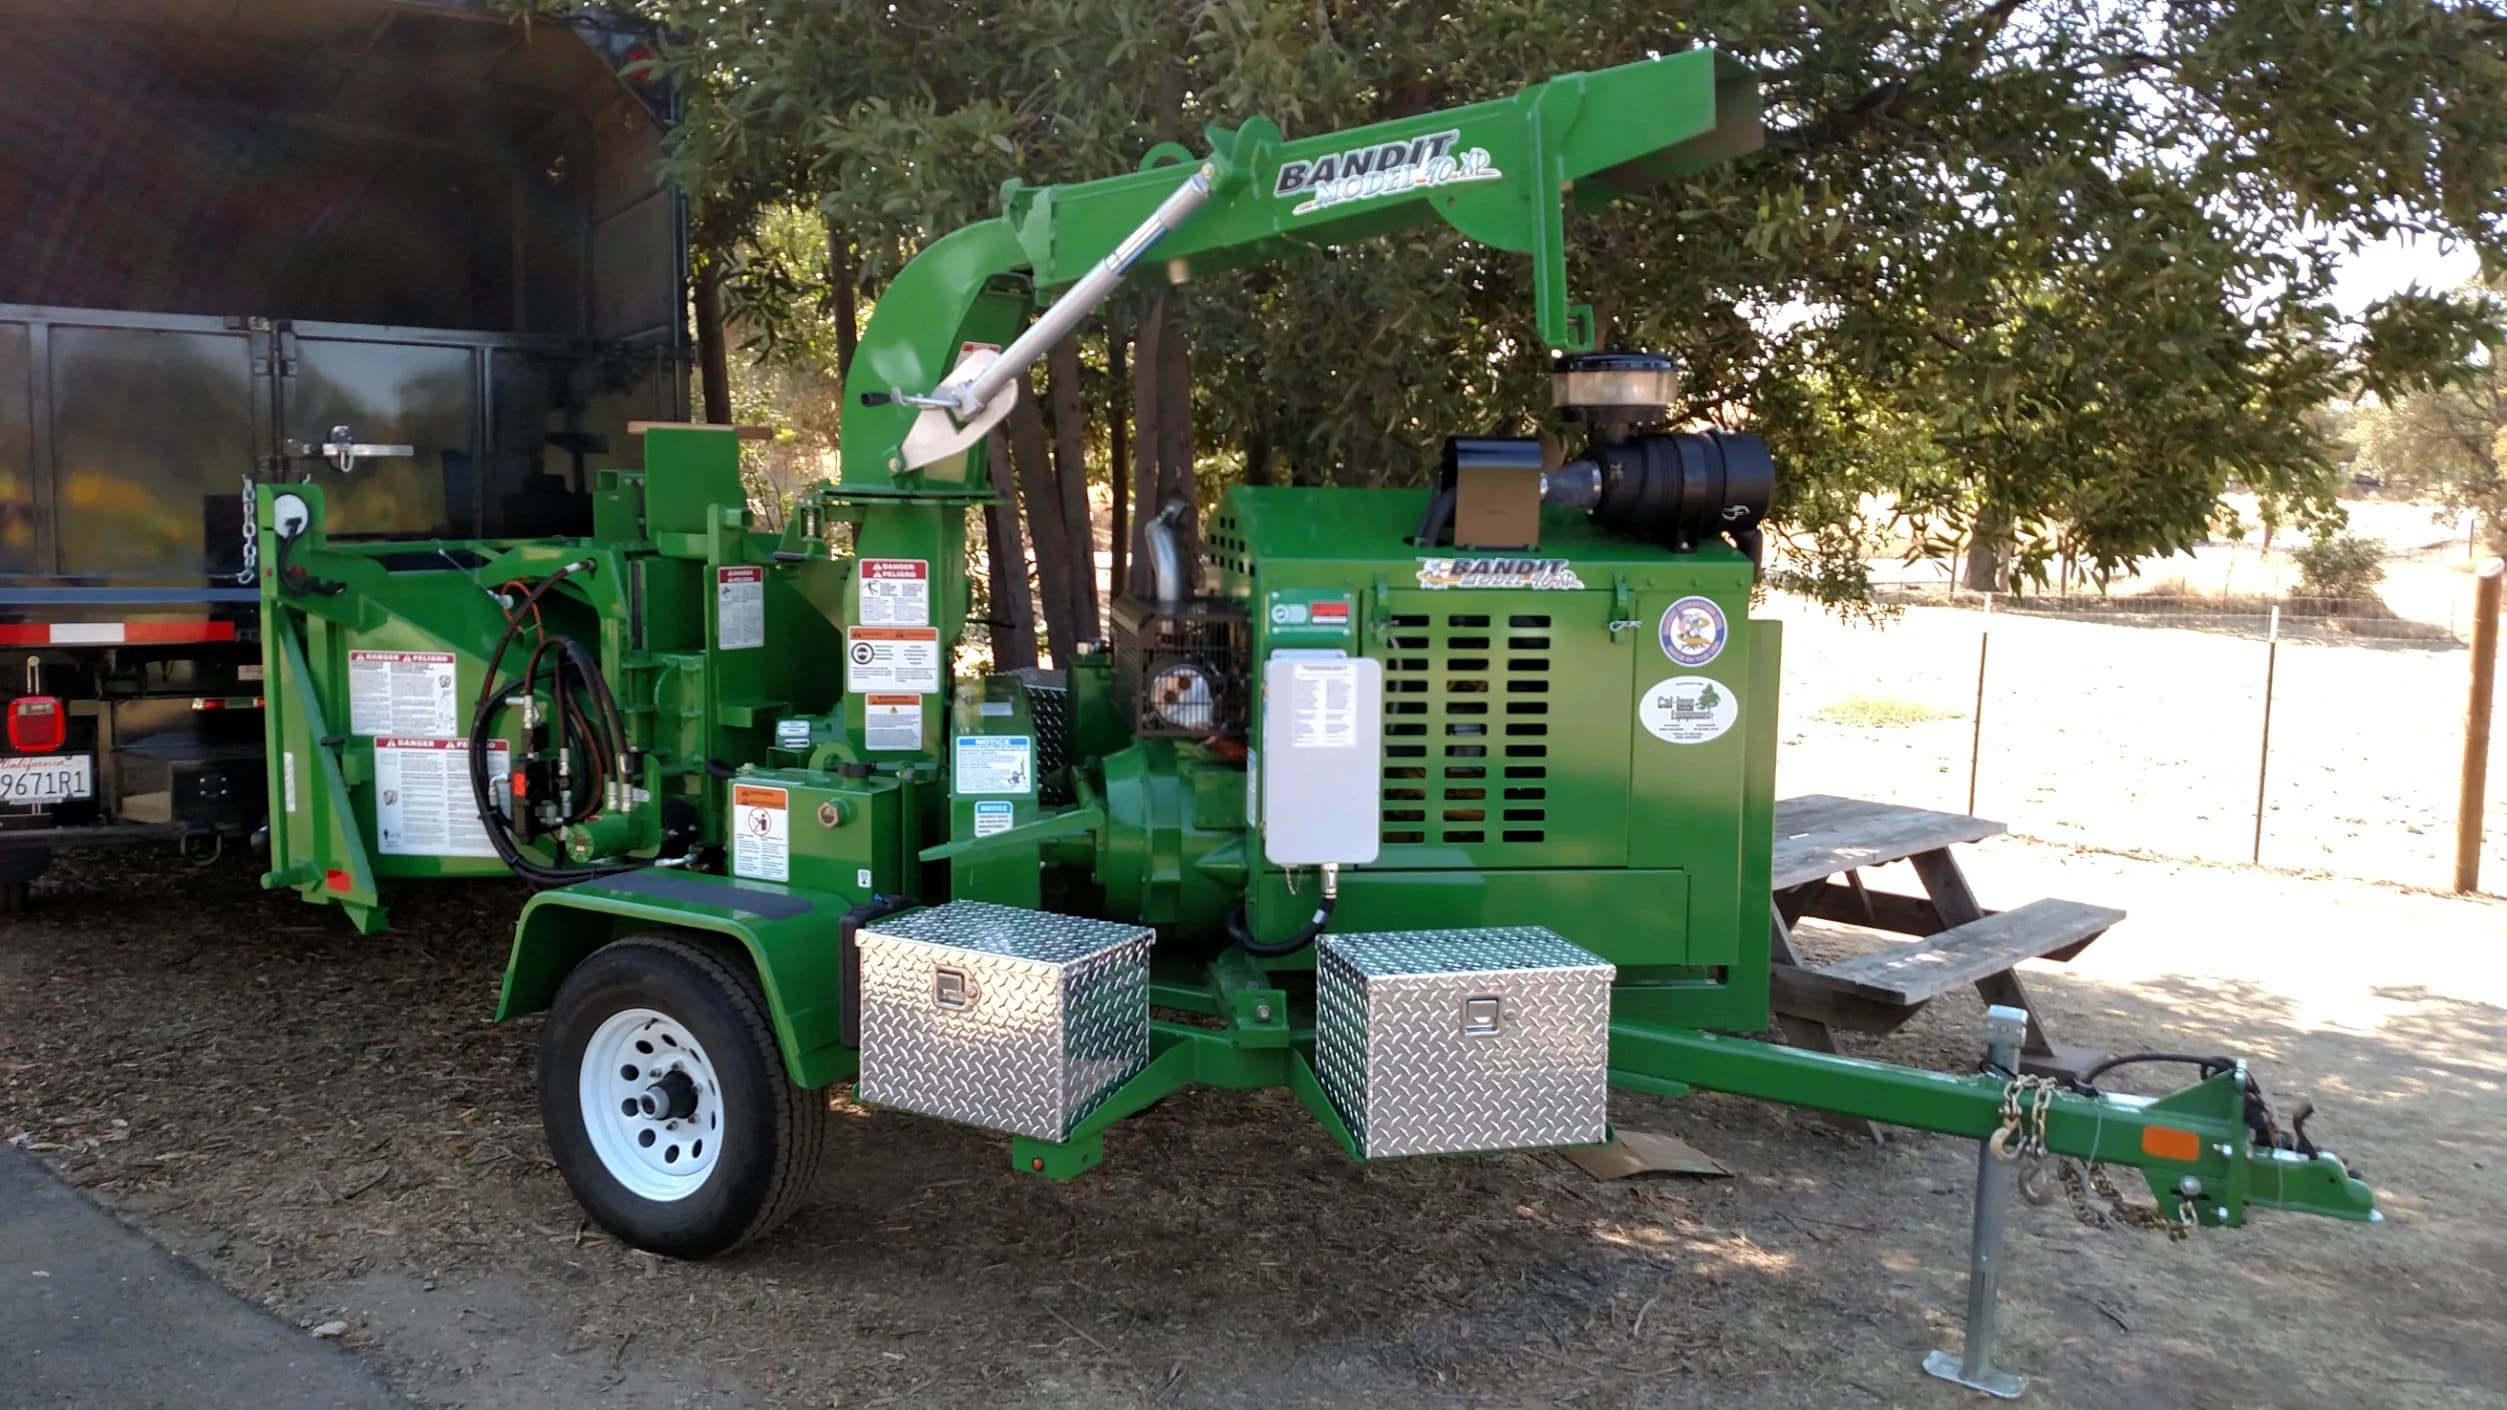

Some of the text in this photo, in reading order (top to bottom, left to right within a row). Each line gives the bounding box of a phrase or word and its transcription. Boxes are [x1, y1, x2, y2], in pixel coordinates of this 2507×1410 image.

[1276, 132, 1456, 194] BANDIT
[1451, 559, 1564, 576] BANDIT
[397, 739, 435, 748] DANGER
[0, 770, 86, 801] 9671R1
